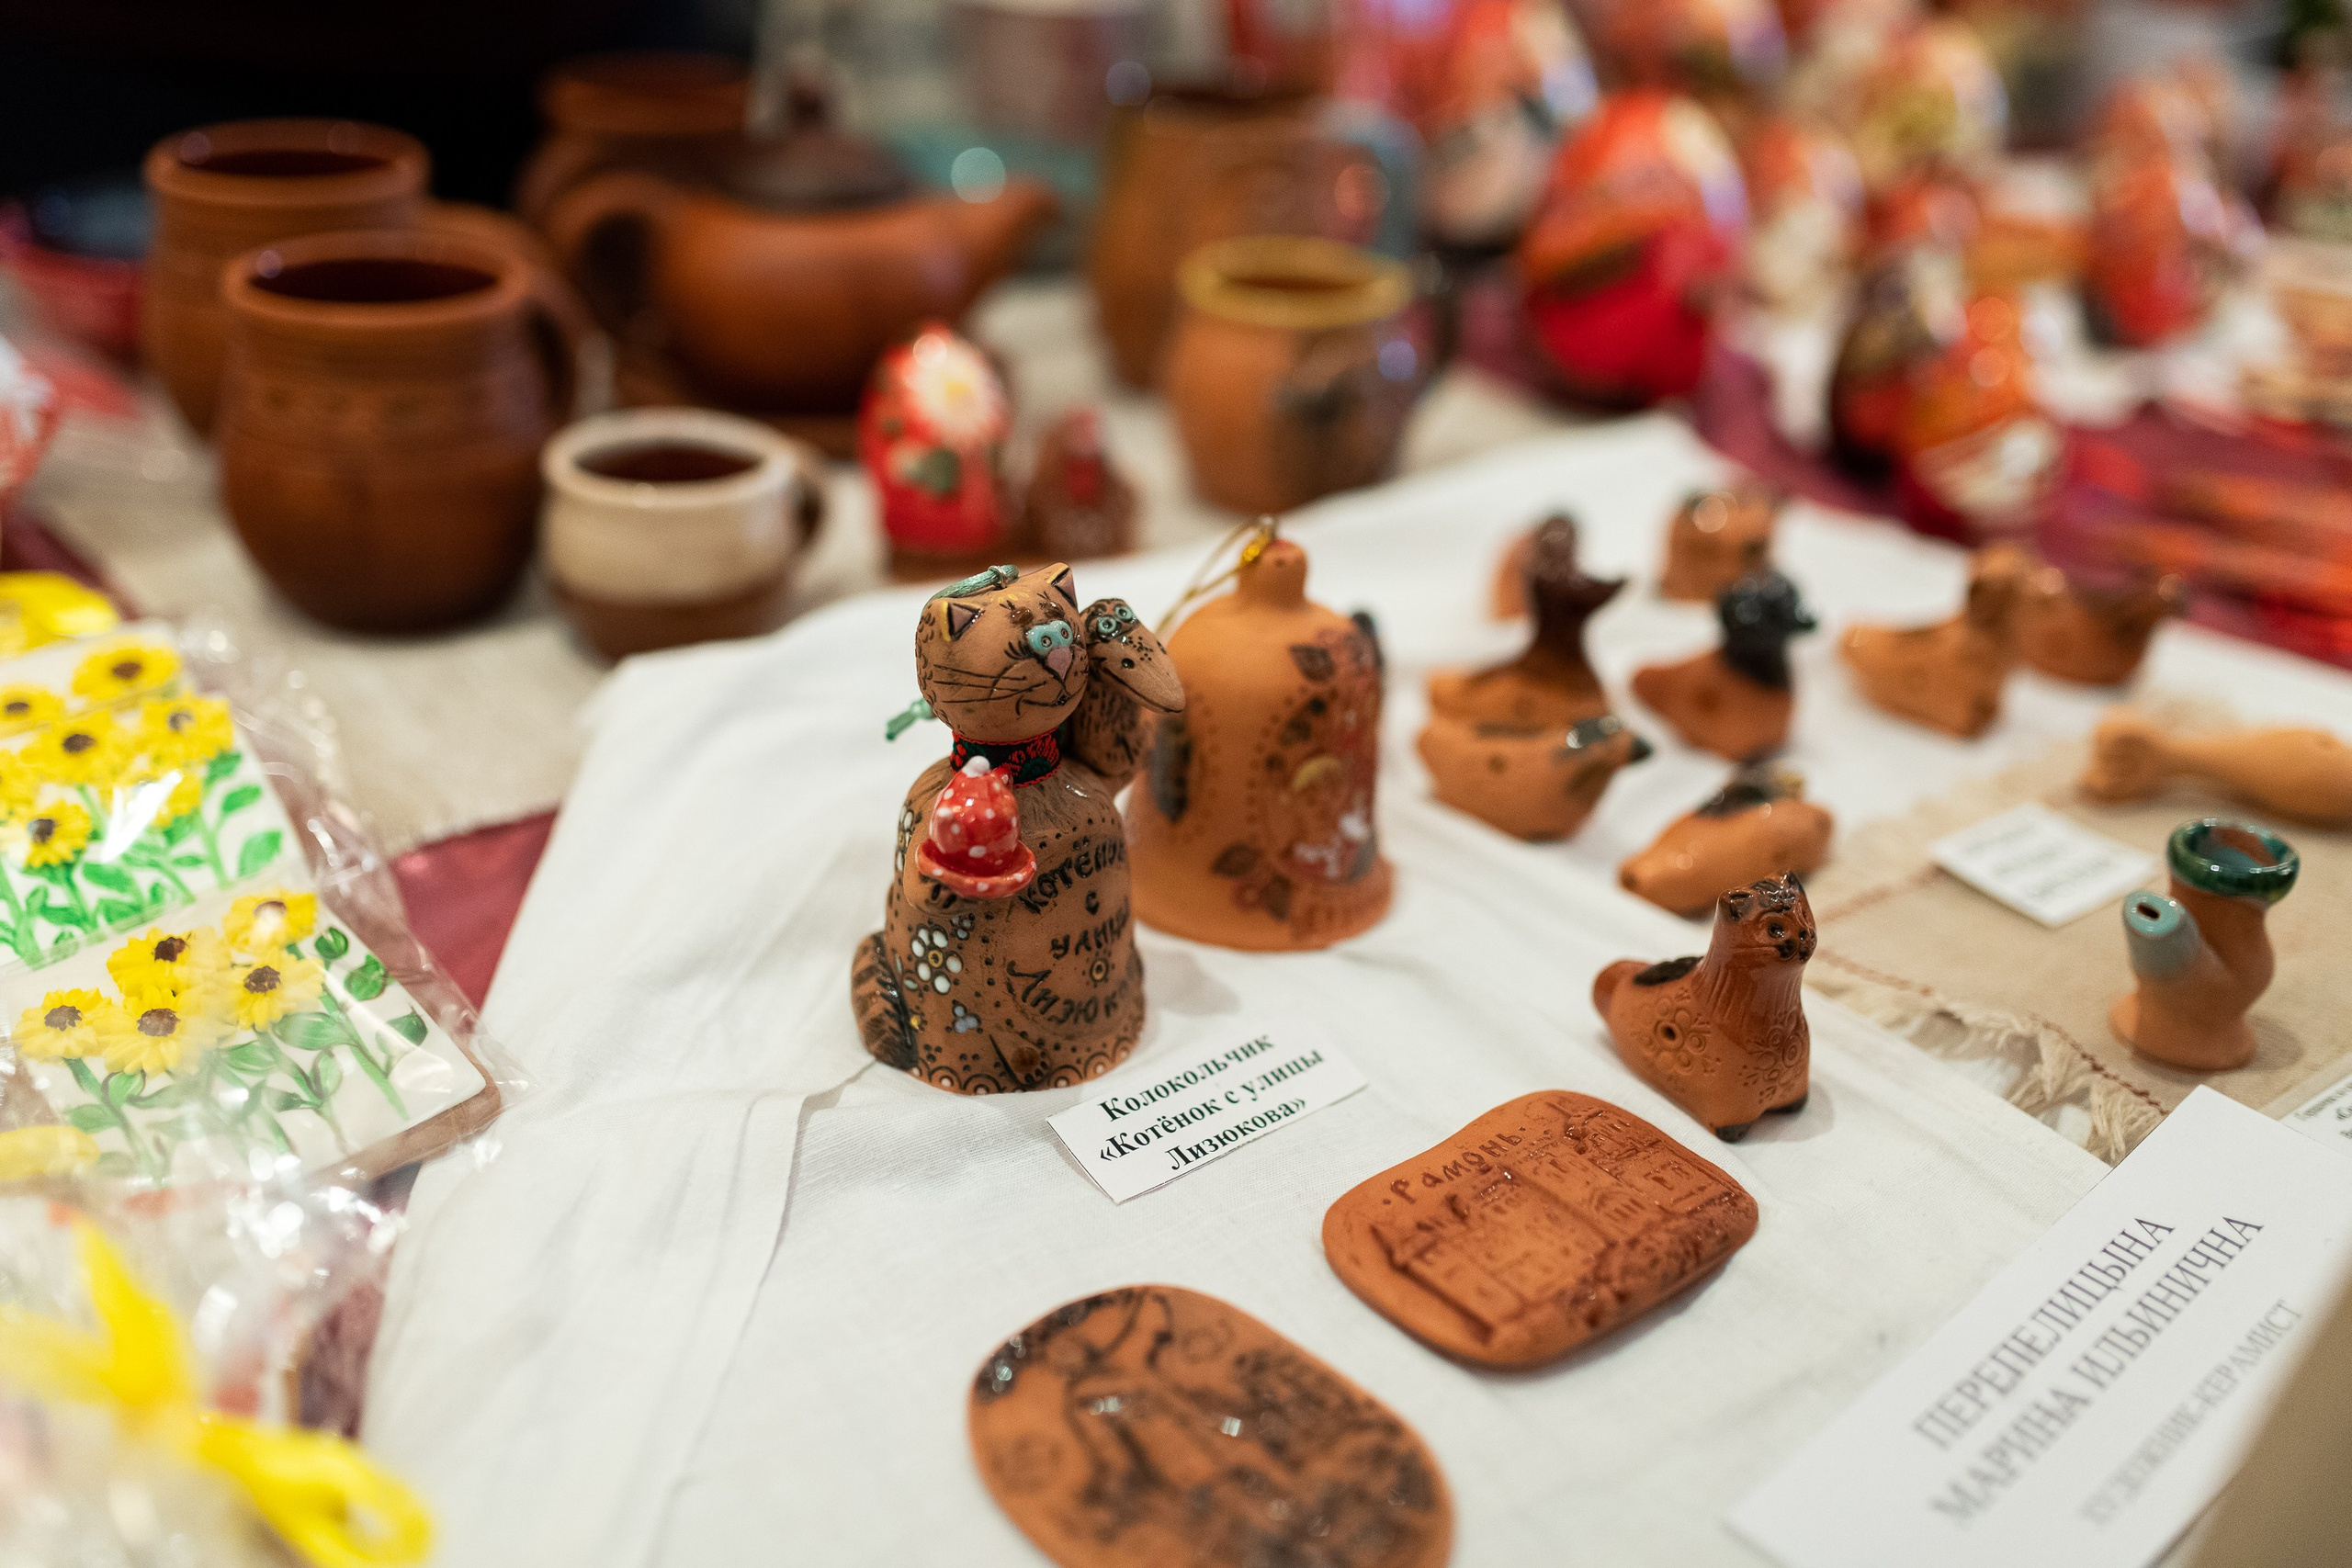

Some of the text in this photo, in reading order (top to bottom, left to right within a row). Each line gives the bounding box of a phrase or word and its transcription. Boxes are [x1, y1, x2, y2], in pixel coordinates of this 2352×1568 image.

[1097, 1034, 1275, 1122] Колокольчик
[1099, 1049, 1326, 1163] «Котёнок с улицы
[1164, 1097, 1307, 1171] Лизюкова»
[1911, 1217, 2176, 1450] ПЕРЕПЕЛИЦЫНА
[1929, 1215, 2266, 1529] МАРИНА ИЛЬИНИЧНА
